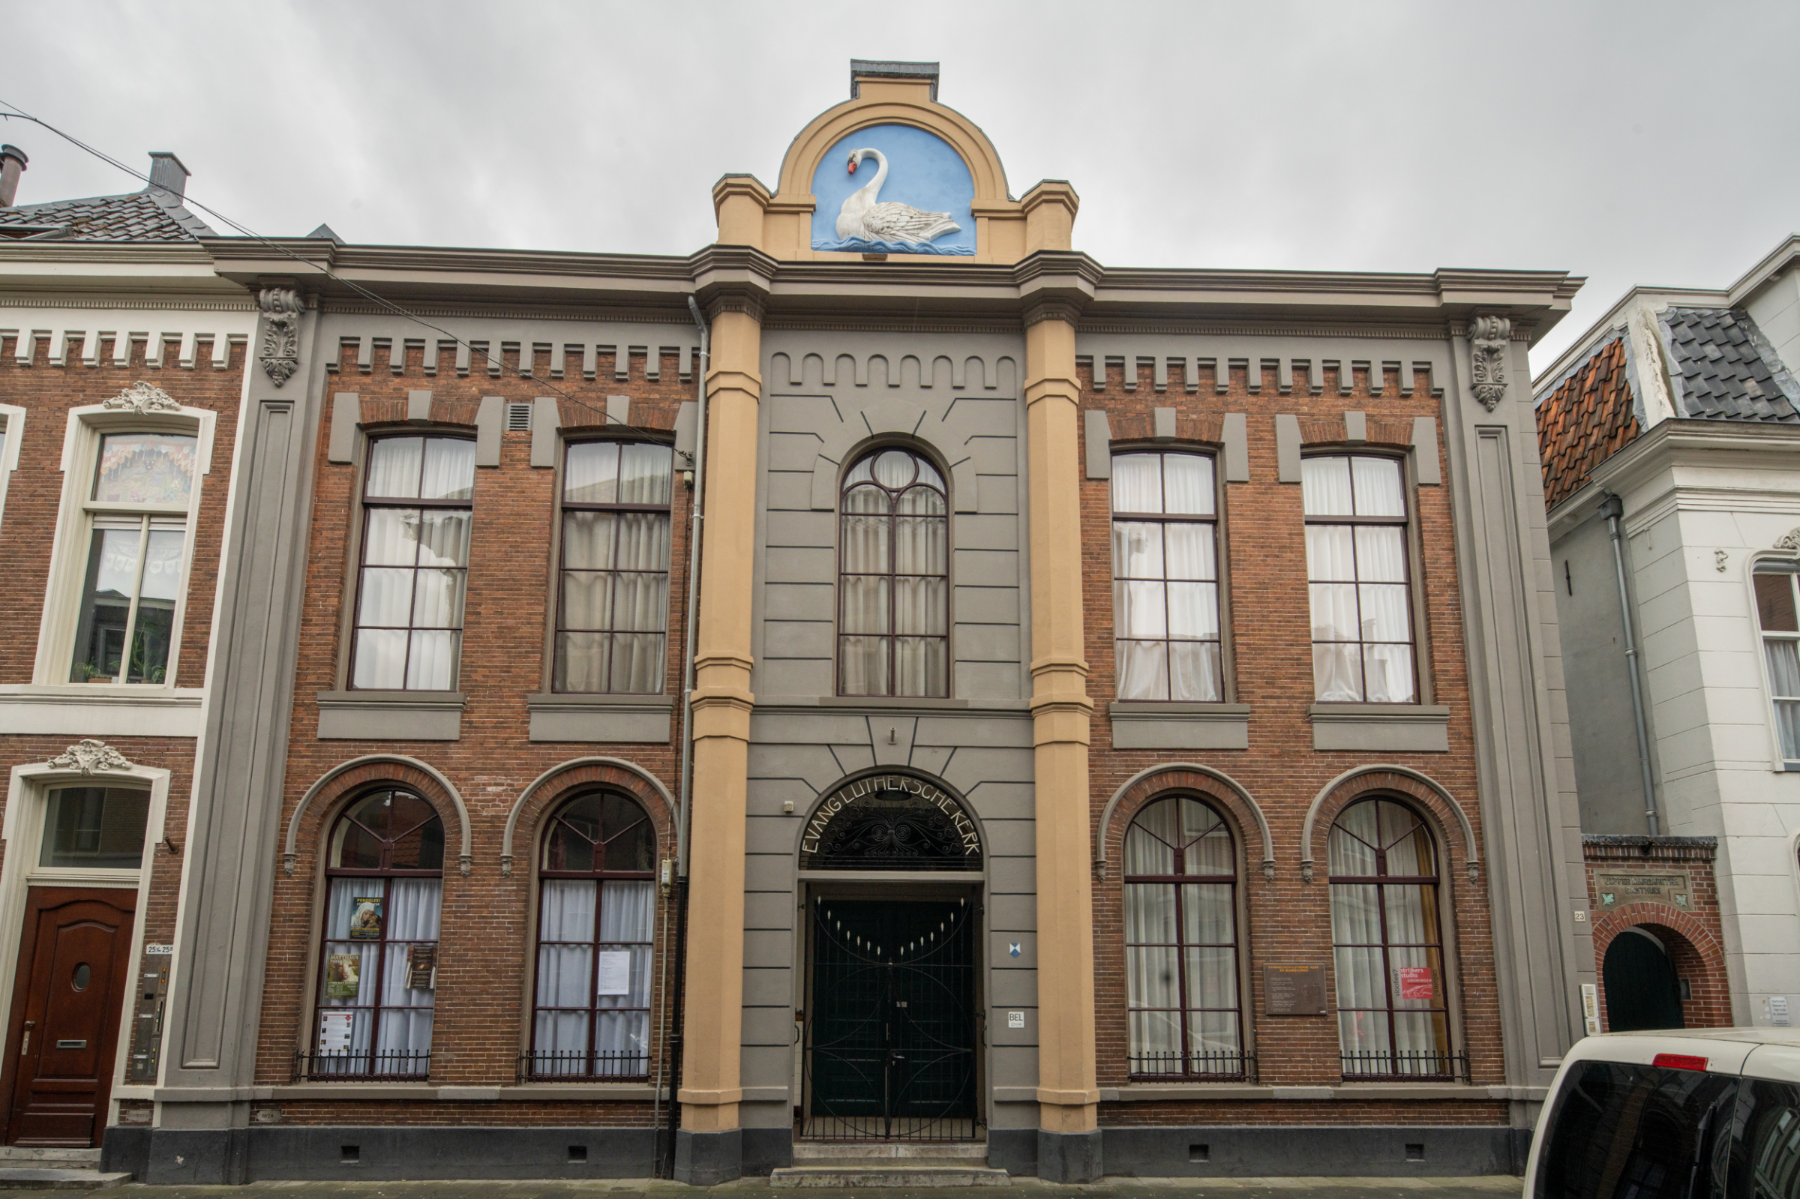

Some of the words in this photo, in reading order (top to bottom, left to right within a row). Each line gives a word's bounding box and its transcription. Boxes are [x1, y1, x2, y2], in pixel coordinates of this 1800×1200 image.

[802, 797, 842, 853] EVANG
[839, 775, 957, 815] LUTHERSCHE
[950, 809, 980, 856] KERK
